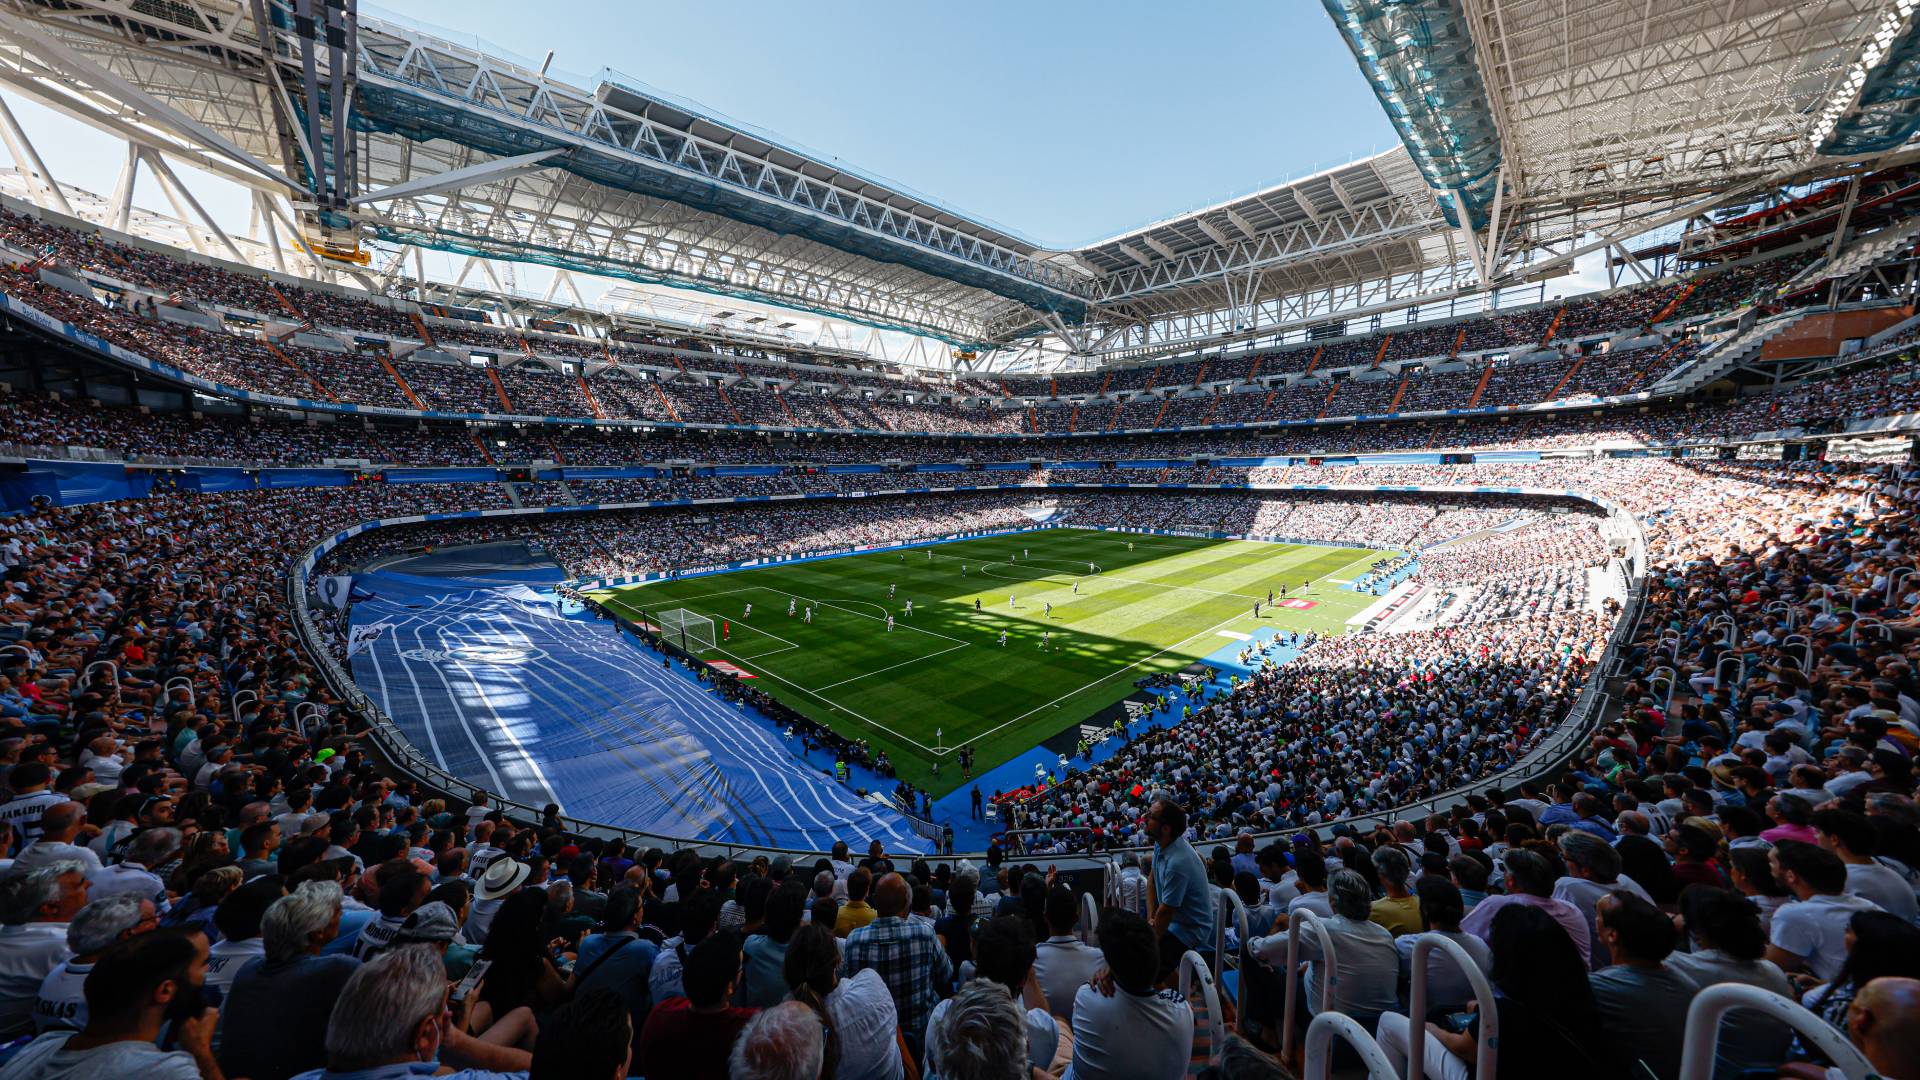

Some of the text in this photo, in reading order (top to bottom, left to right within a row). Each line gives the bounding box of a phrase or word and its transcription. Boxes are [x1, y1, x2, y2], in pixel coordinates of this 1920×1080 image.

[22, 305, 34, 320] Real
[324, 402, 342, 410] Madrid
[1170, 529, 1194, 537] cantabria
[815, 547, 852, 557] cantabria labs
[680, 563, 729, 576] cantabria labs
